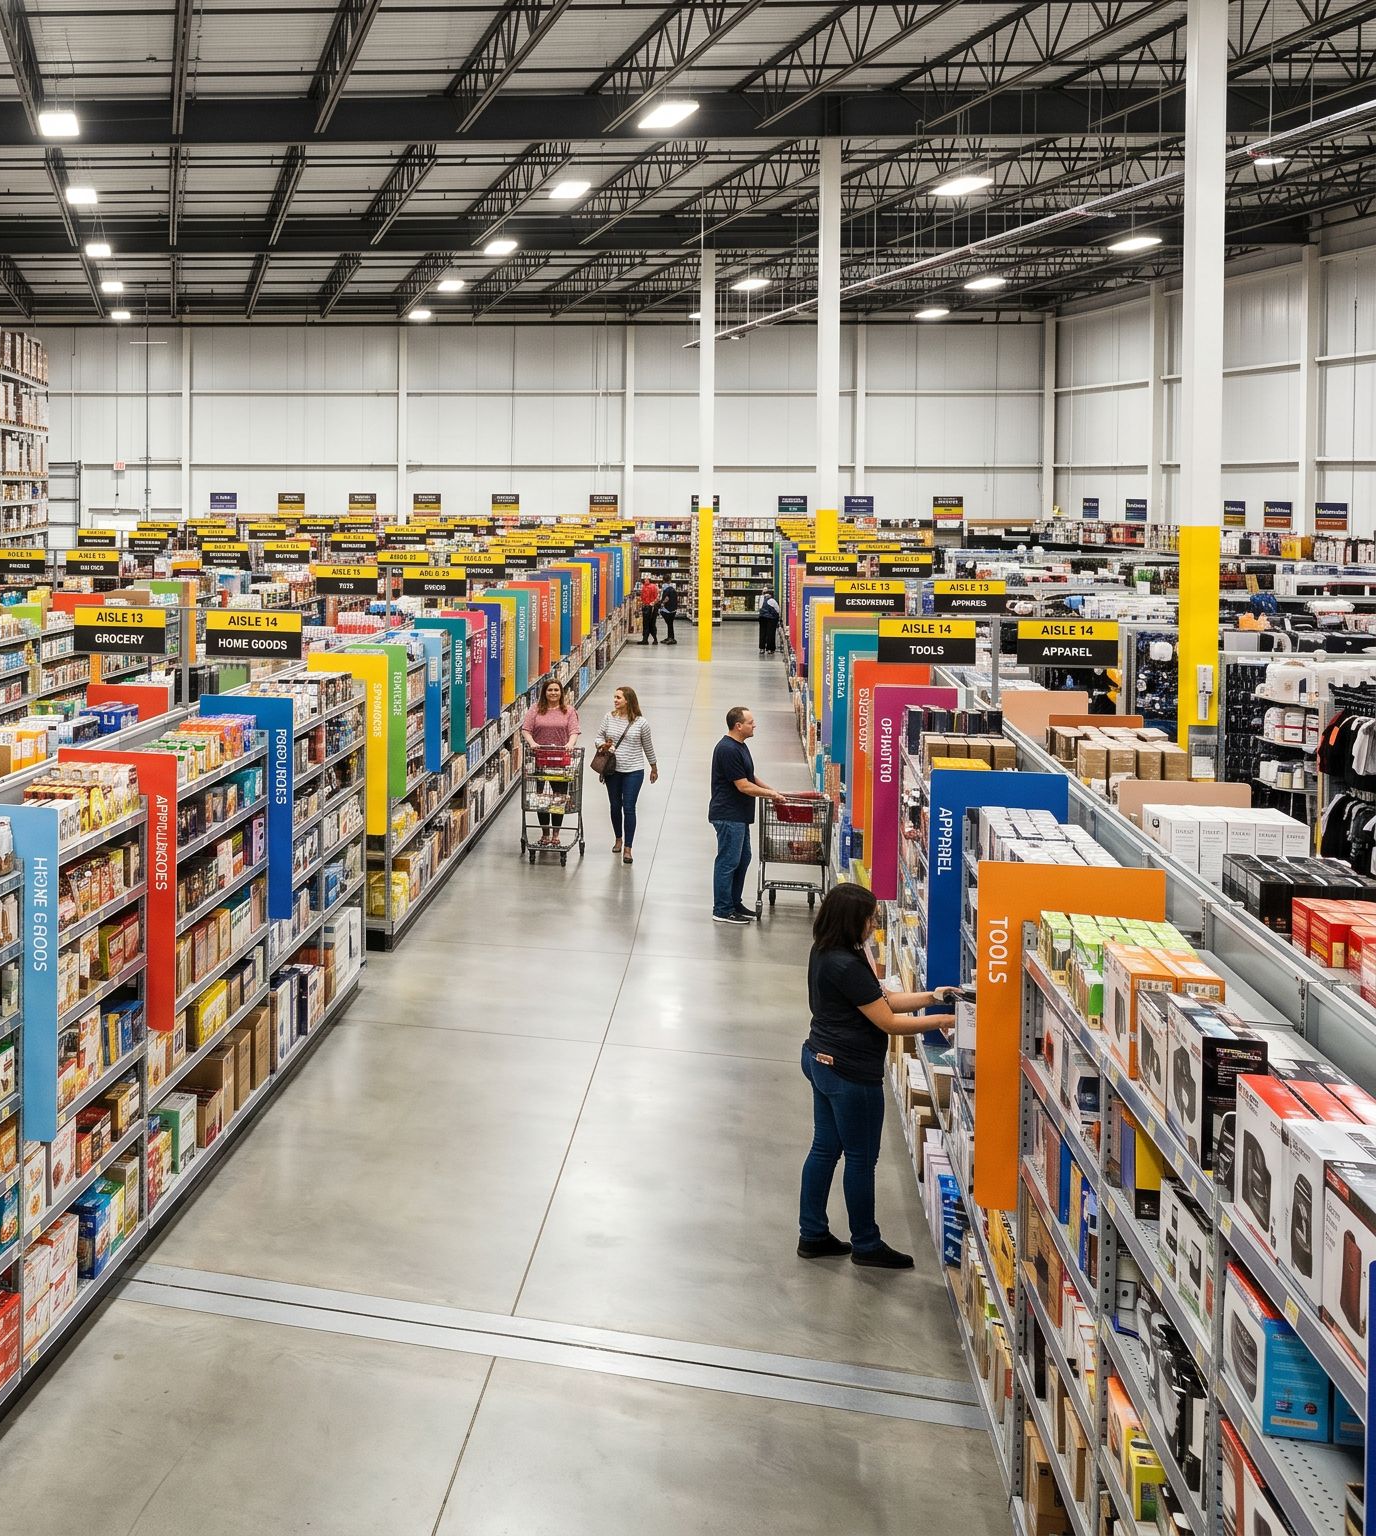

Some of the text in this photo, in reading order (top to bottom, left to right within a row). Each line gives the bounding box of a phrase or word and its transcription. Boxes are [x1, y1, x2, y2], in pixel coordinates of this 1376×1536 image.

[850, 583, 890, 591] AISLE 13
[979, 584, 989, 592] 13
[96, 612, 143, 623] AISLE 13
[228, 615, 278, 627] AISLE 14
[901, 624, 952, 634] AISLE 14
[1041, 625, 1094, 635] AISLE 14
[95, 633, 144, 644] GROCERY
[218, 638, 288, 650] HOME GOODS
[909, 646, 944, 655] TOOLS
[1042, 647, 1092, 657] APPAREL
[988, 916, 1009, 984] TOOLS
